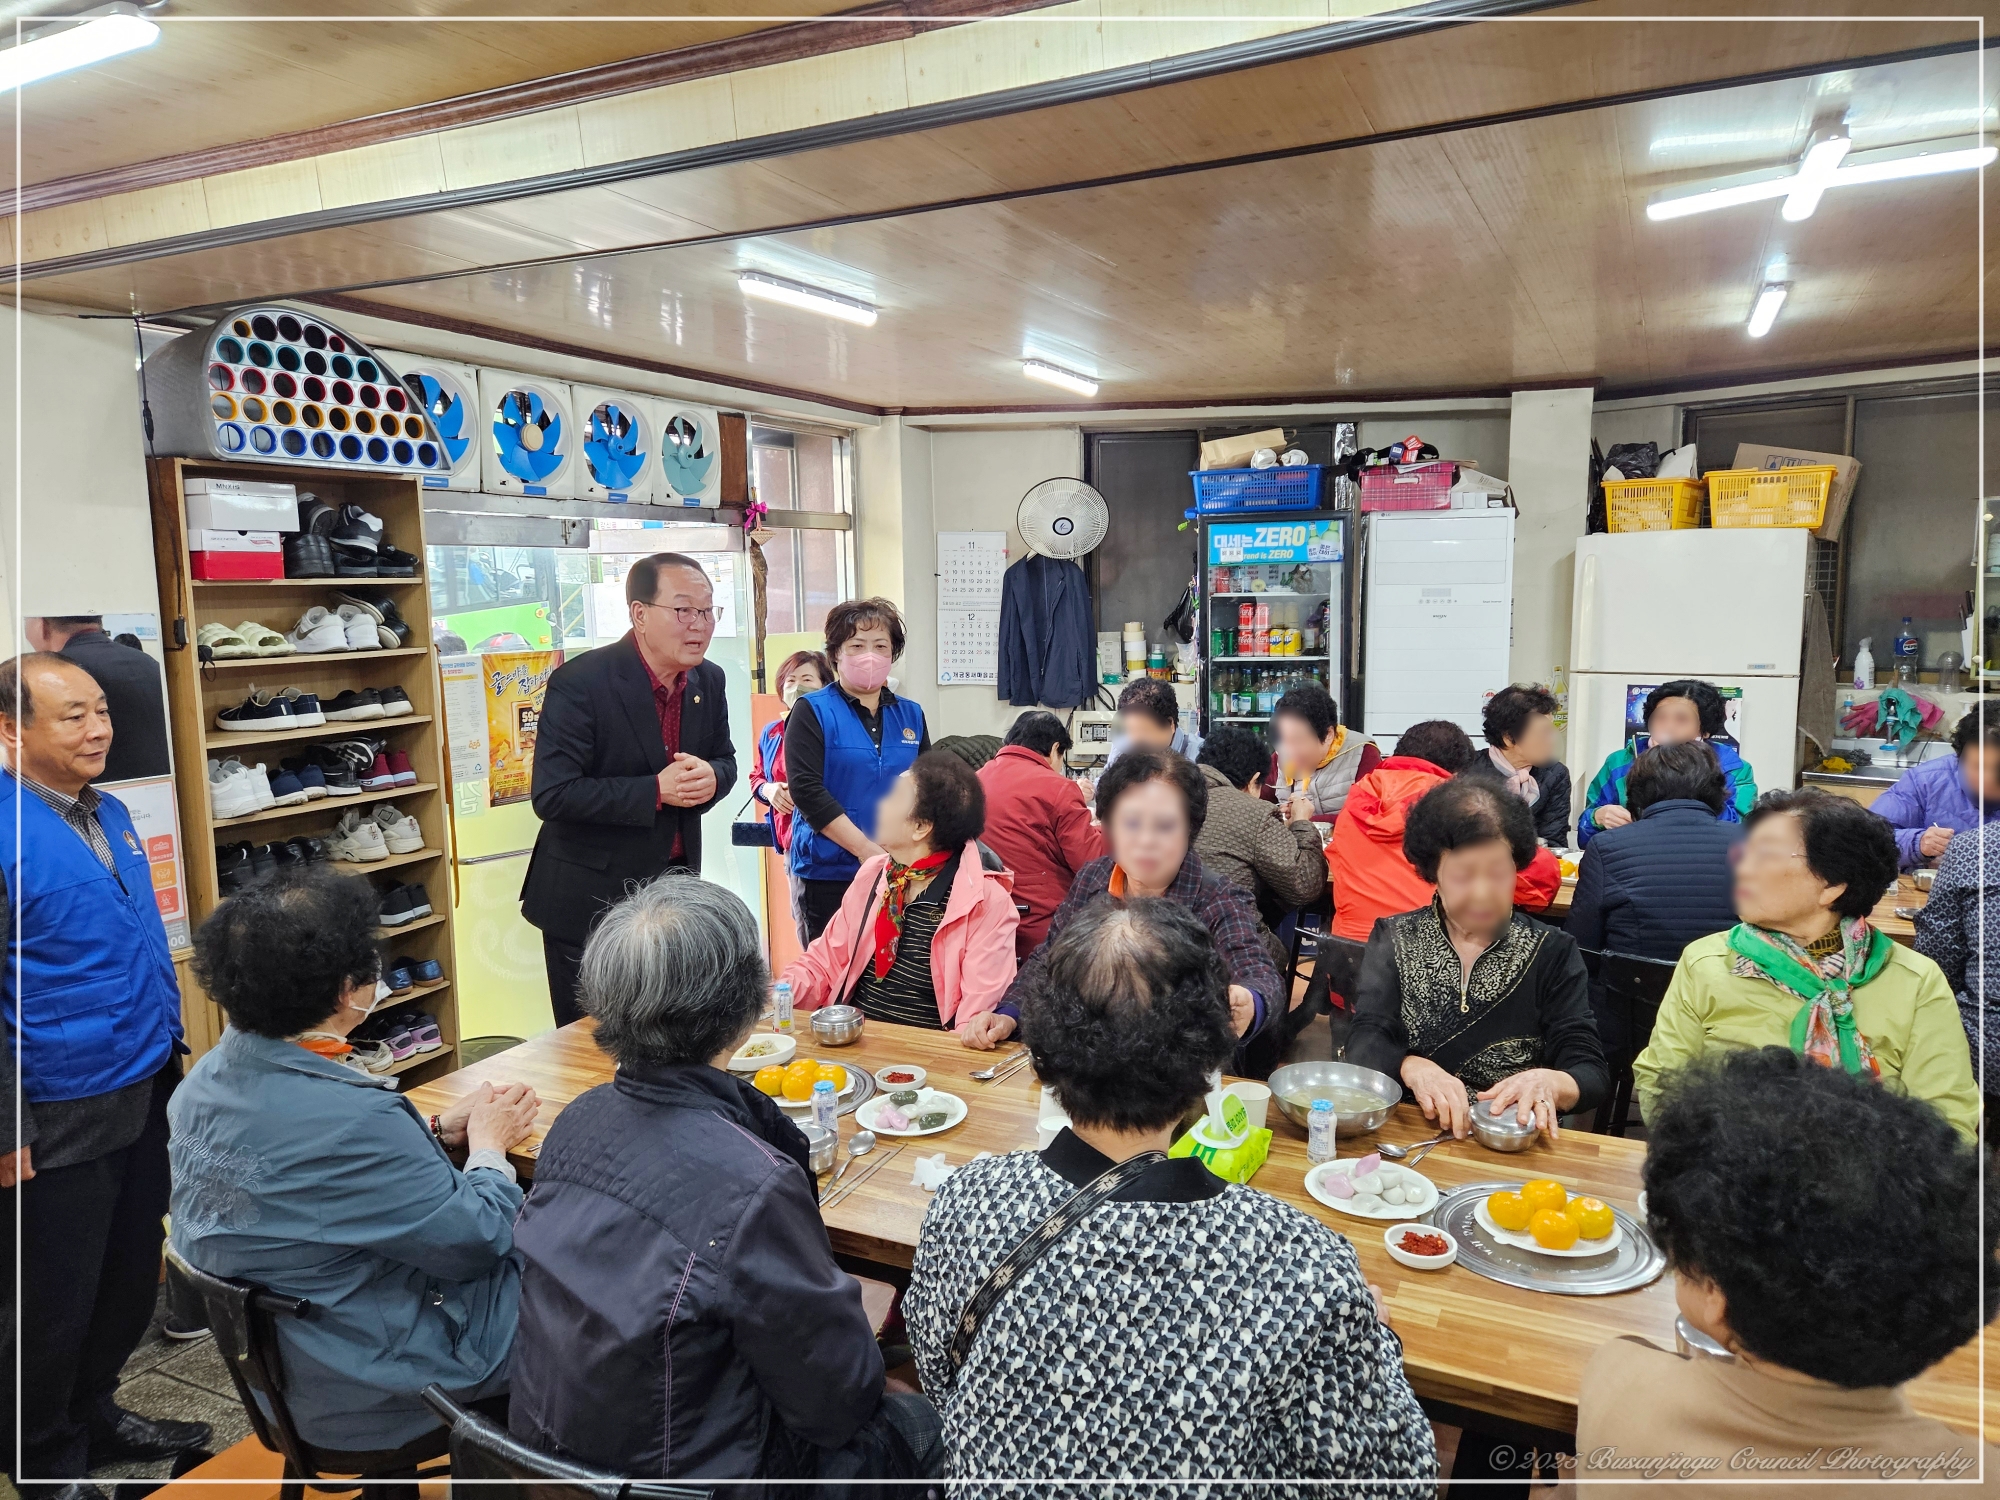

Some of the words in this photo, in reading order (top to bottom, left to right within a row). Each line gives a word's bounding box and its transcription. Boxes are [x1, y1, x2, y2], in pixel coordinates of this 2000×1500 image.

[1214, 534, 1253, 548] 대세는
[1254, 525, 1306, 547] ZERO
[968, 541, 975, 549] 11
[1268, 549, 1294, 559] ZERO
[968, 613, 975, 621] 12
